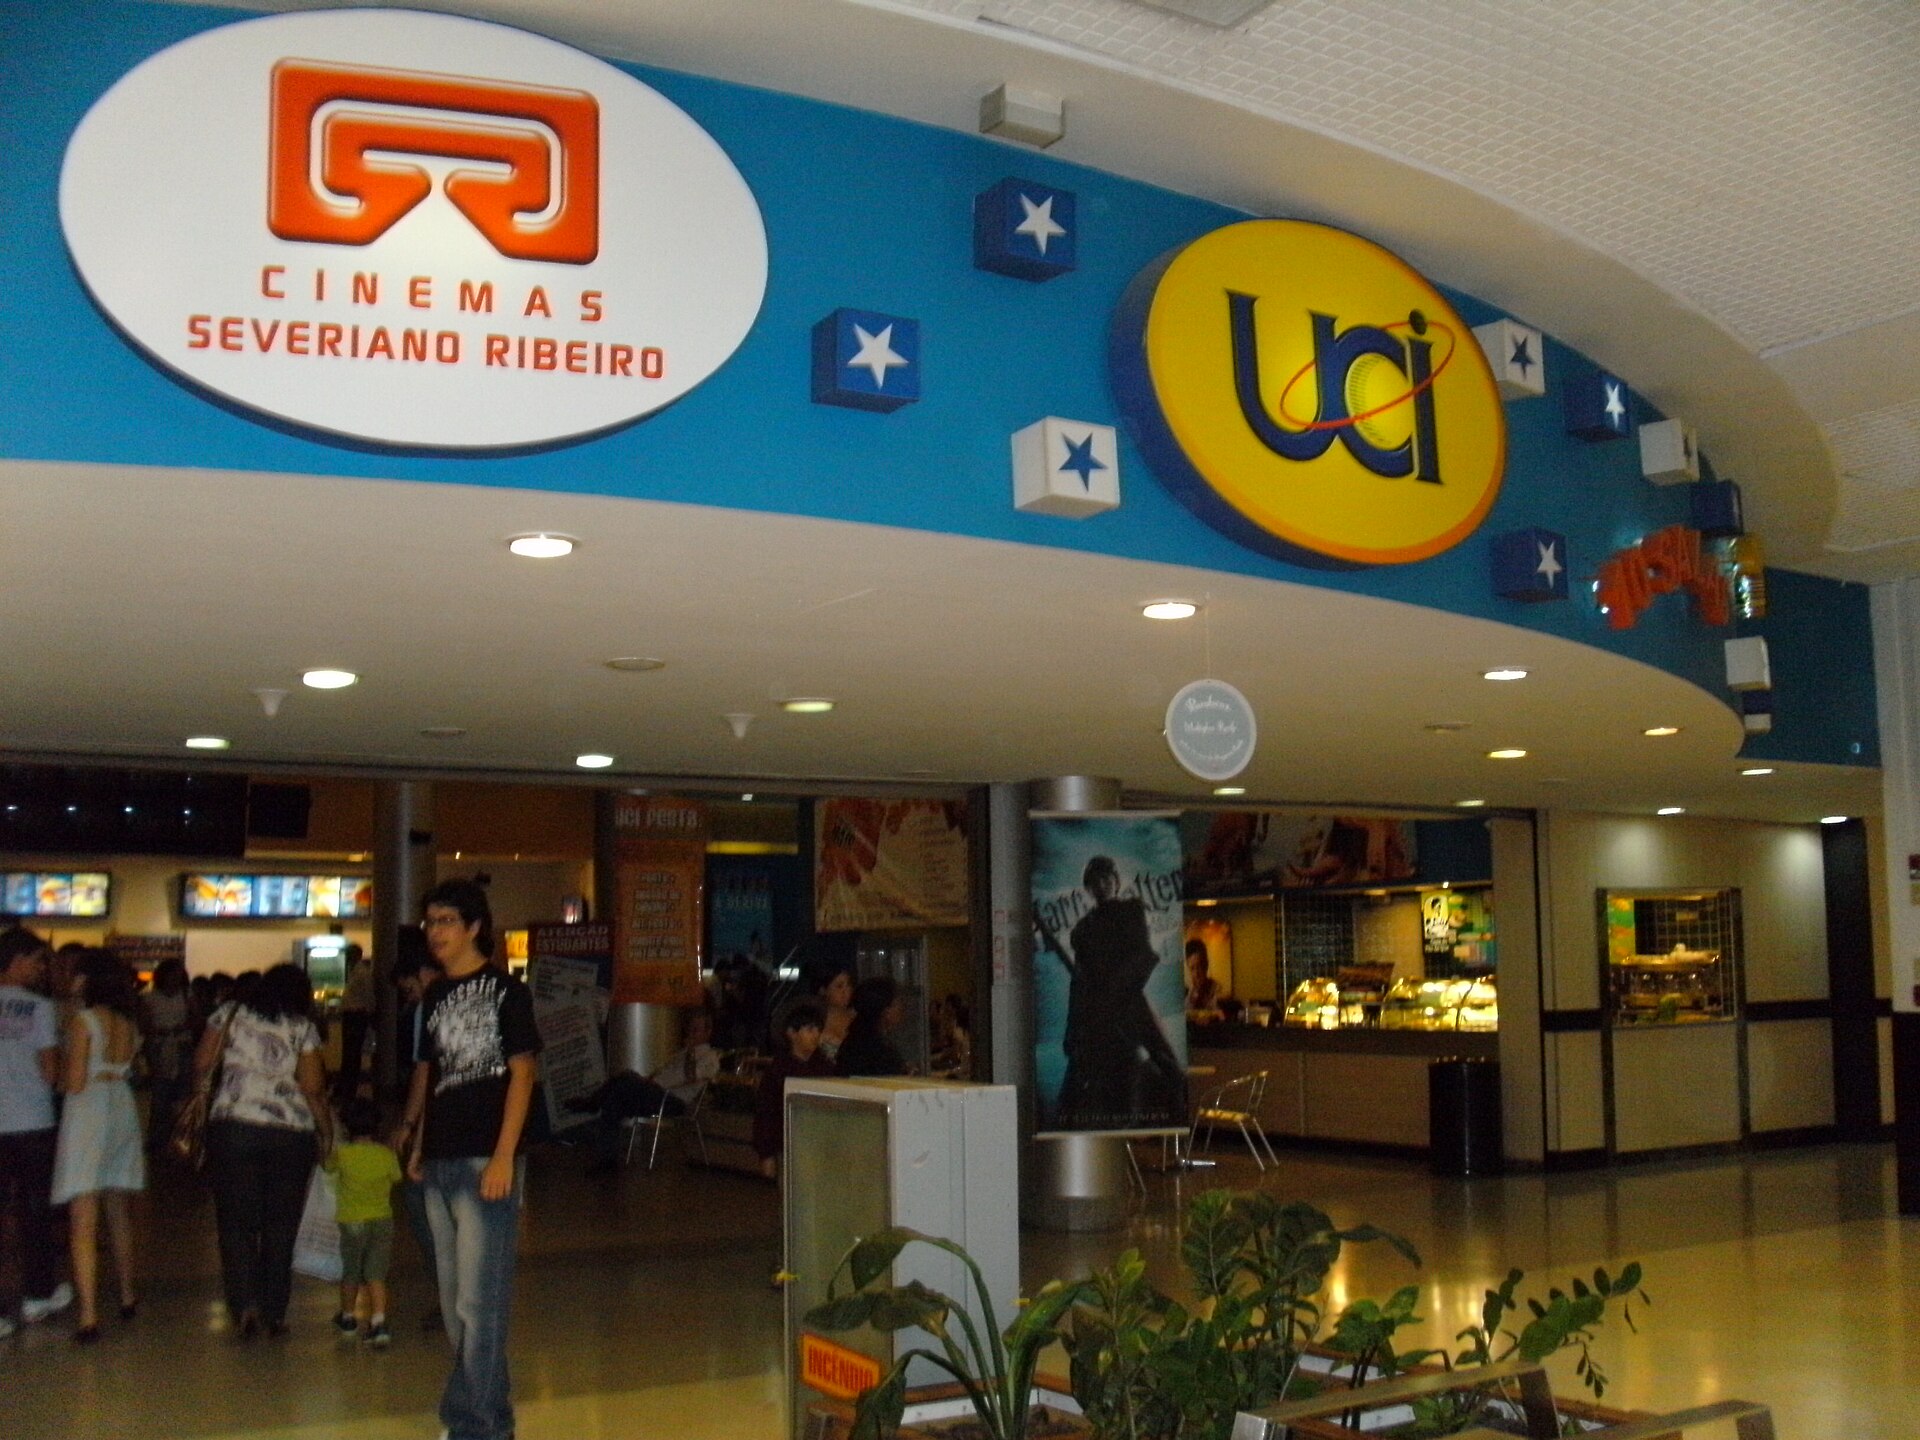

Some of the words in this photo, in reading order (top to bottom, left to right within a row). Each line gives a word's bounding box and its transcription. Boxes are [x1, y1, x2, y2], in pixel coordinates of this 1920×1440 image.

[260, 264, 607, 324] CINEMAS
[186, 313, 463, 366] SEVERIANO
[484, 333, 666, 381] RIBEIRO
